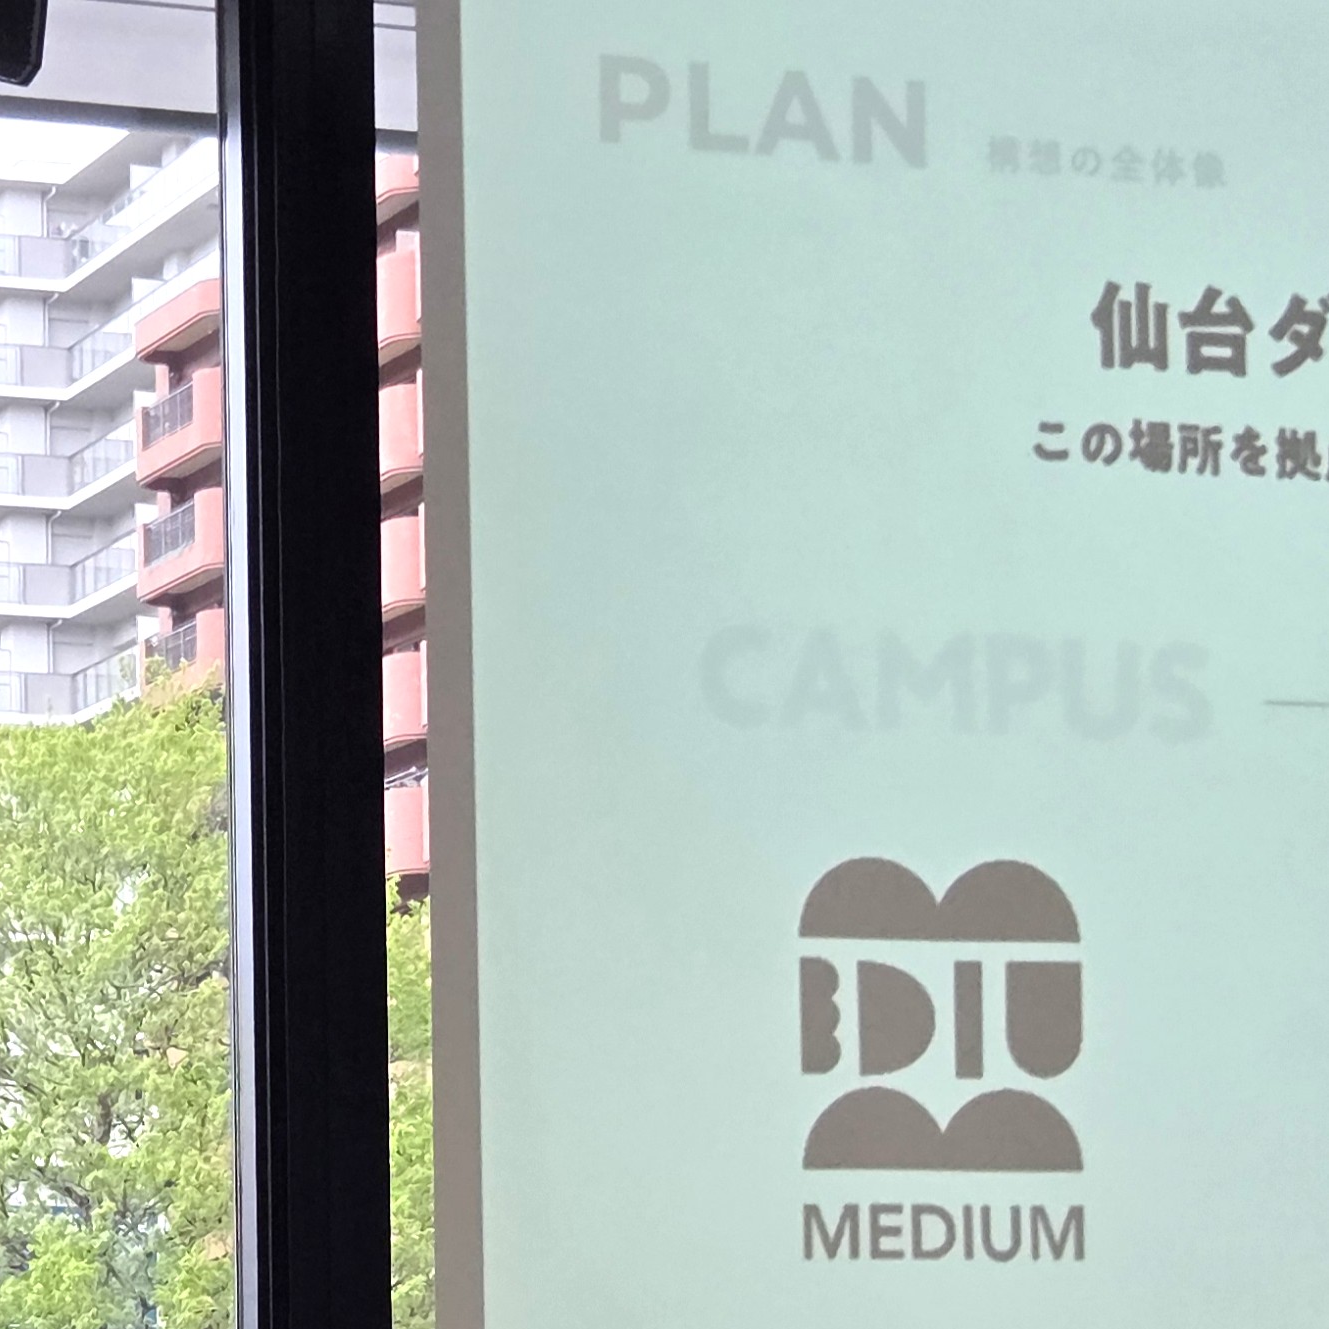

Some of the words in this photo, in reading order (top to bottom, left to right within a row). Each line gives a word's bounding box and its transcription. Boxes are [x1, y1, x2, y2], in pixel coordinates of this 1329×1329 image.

[598, 53, 928, 170] PLAN
[1090, 280, 1329, 378] 仙台ダ
[1033, 417, 1329, 483] この場所を拠
[697, 623, 1215, 745] CAMPUS
[802, 1203, 1087, 1263] MEDIUM
